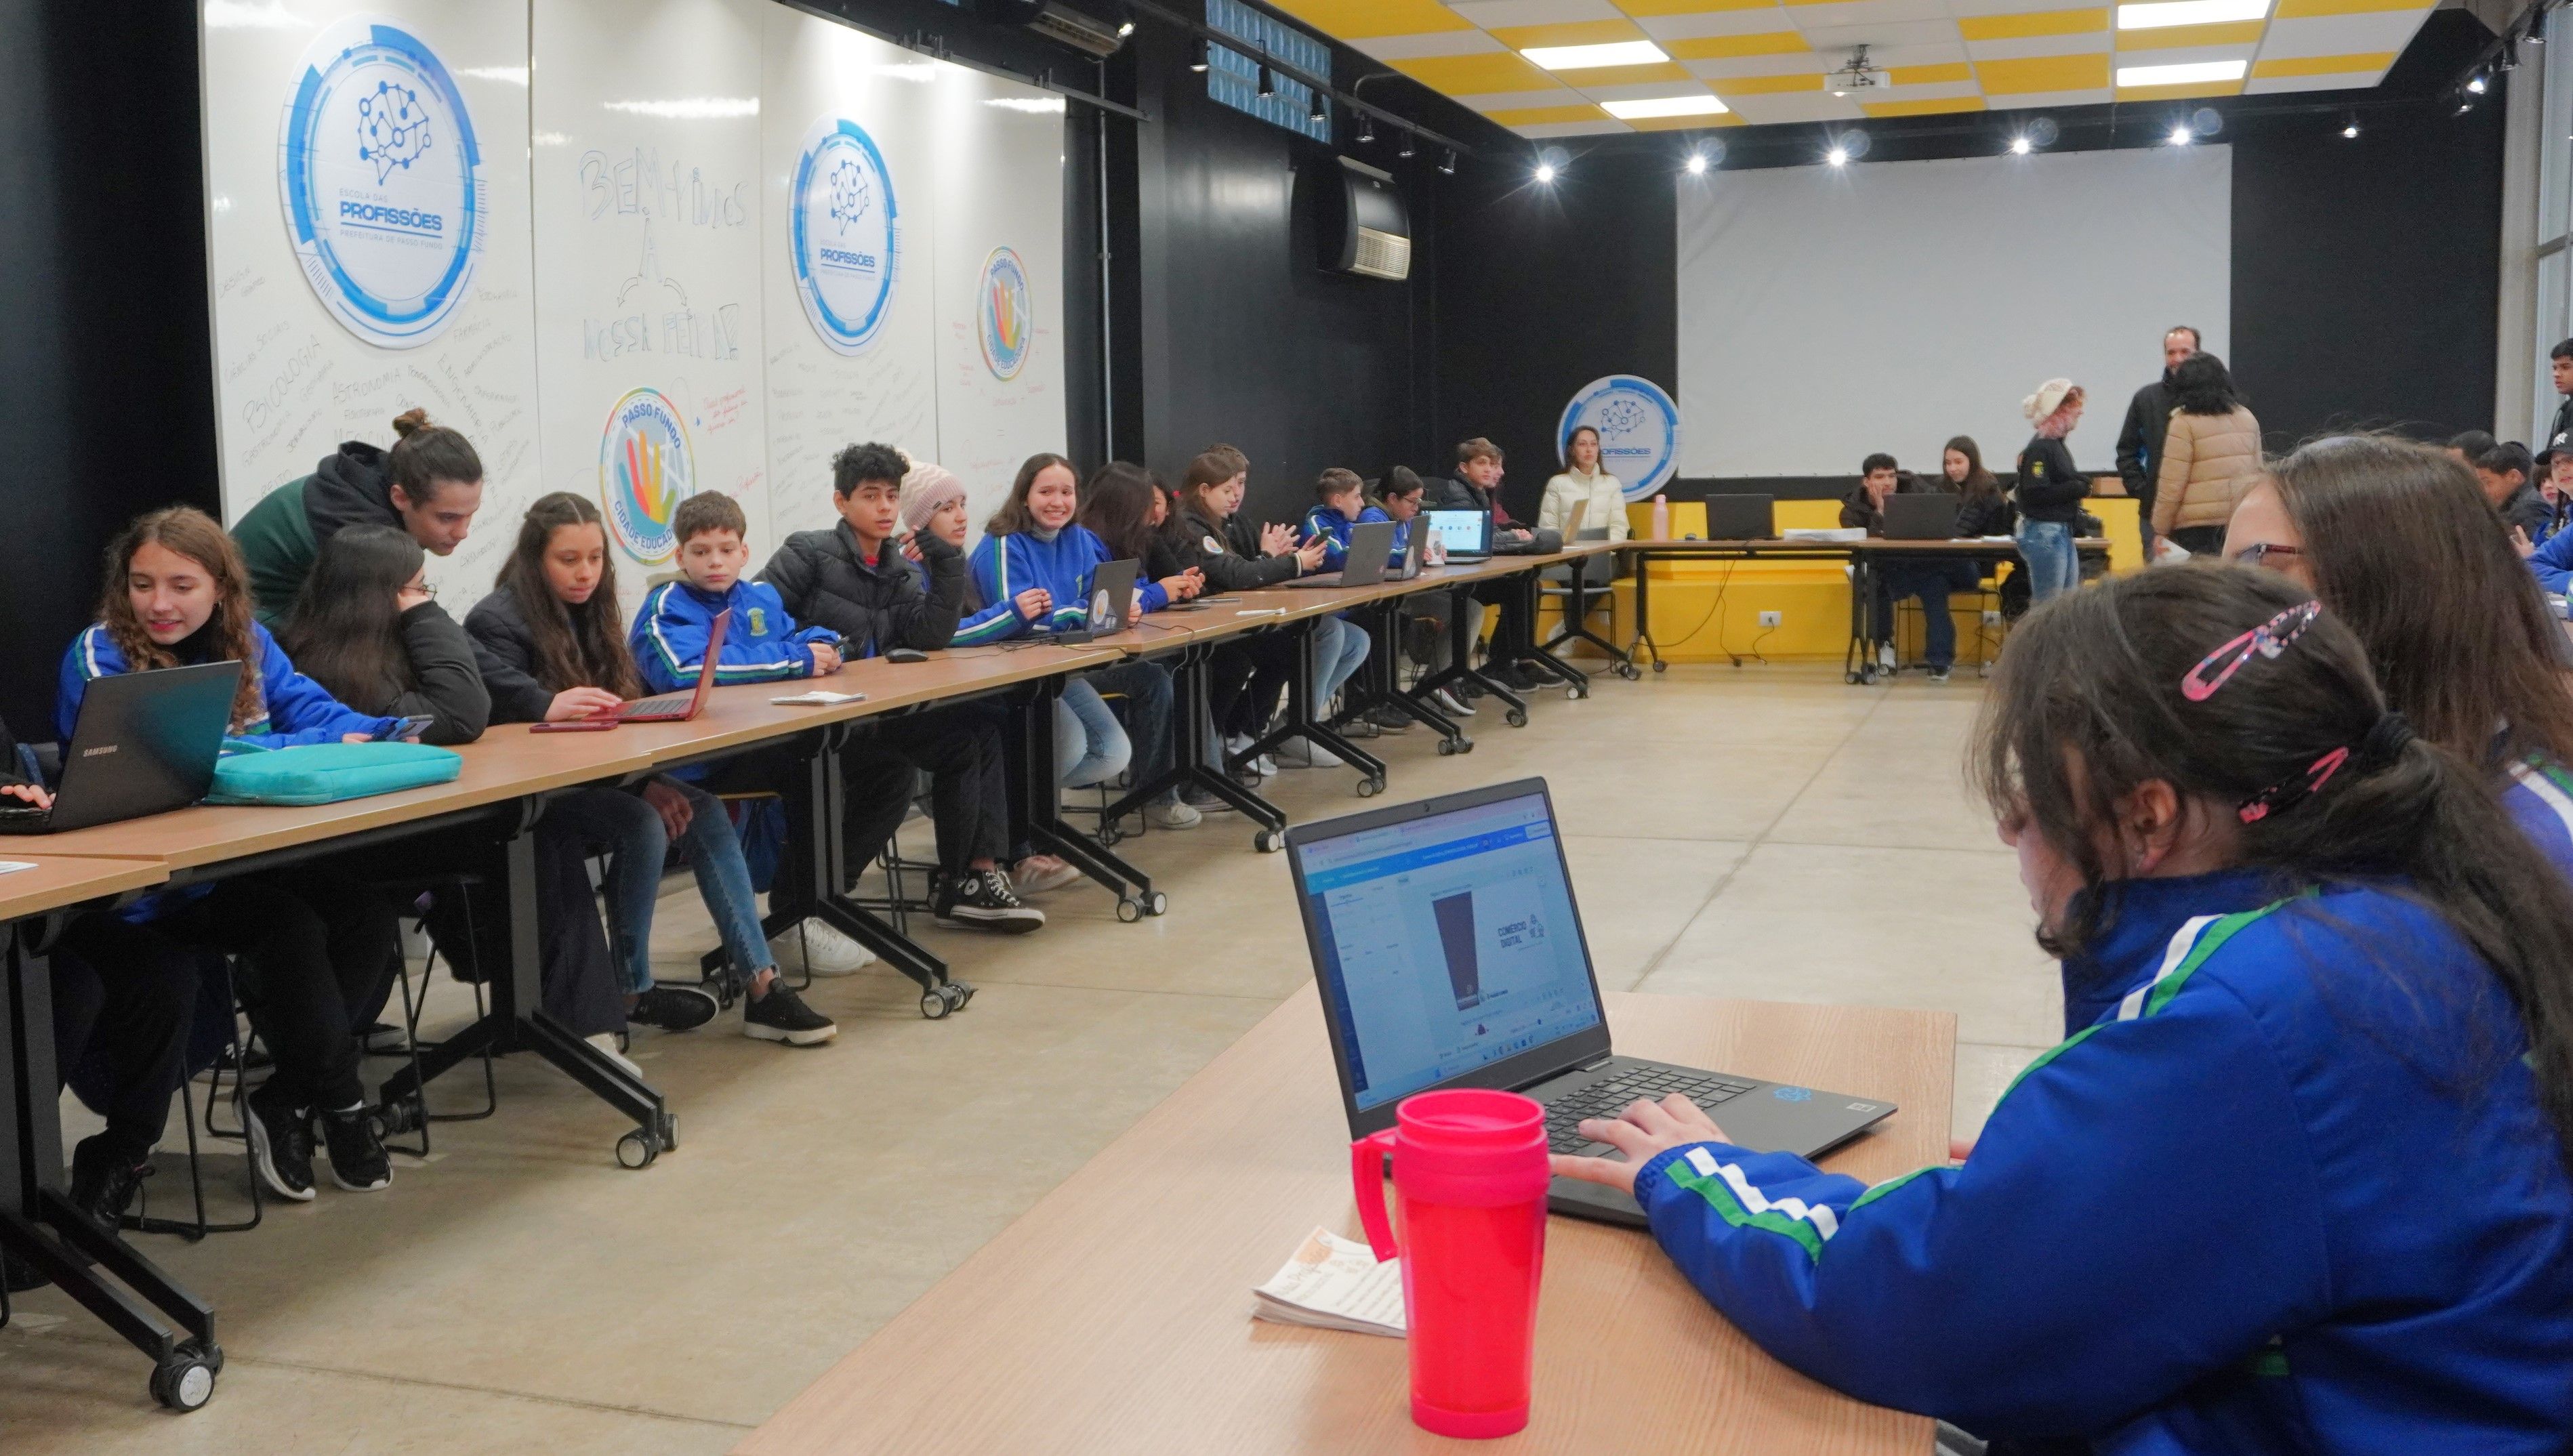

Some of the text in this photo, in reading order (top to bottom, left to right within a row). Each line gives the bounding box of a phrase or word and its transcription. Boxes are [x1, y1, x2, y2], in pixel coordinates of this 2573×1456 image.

[339, 188, 388, 203] ESCOLA DAS
[339, 201, 442, 230] PROFISSÕES
[340, 229, 384, 242] PREFEITURA
[386, 236, 394, 244] DE
[397, 238, 419, 247] PASSO
[820, 248, 876, 268] PROFISSÕES
[332, 368, 402, 408] ASTRONOMIA
[621, 402, 681, 450] PASSO FUNDO
[1601, 446, 1651, 455] OFISSÕES
[614, 500, 676, 549] CIDADE EDUCAD
[83, 745, 118, 757] SAMSUNG
